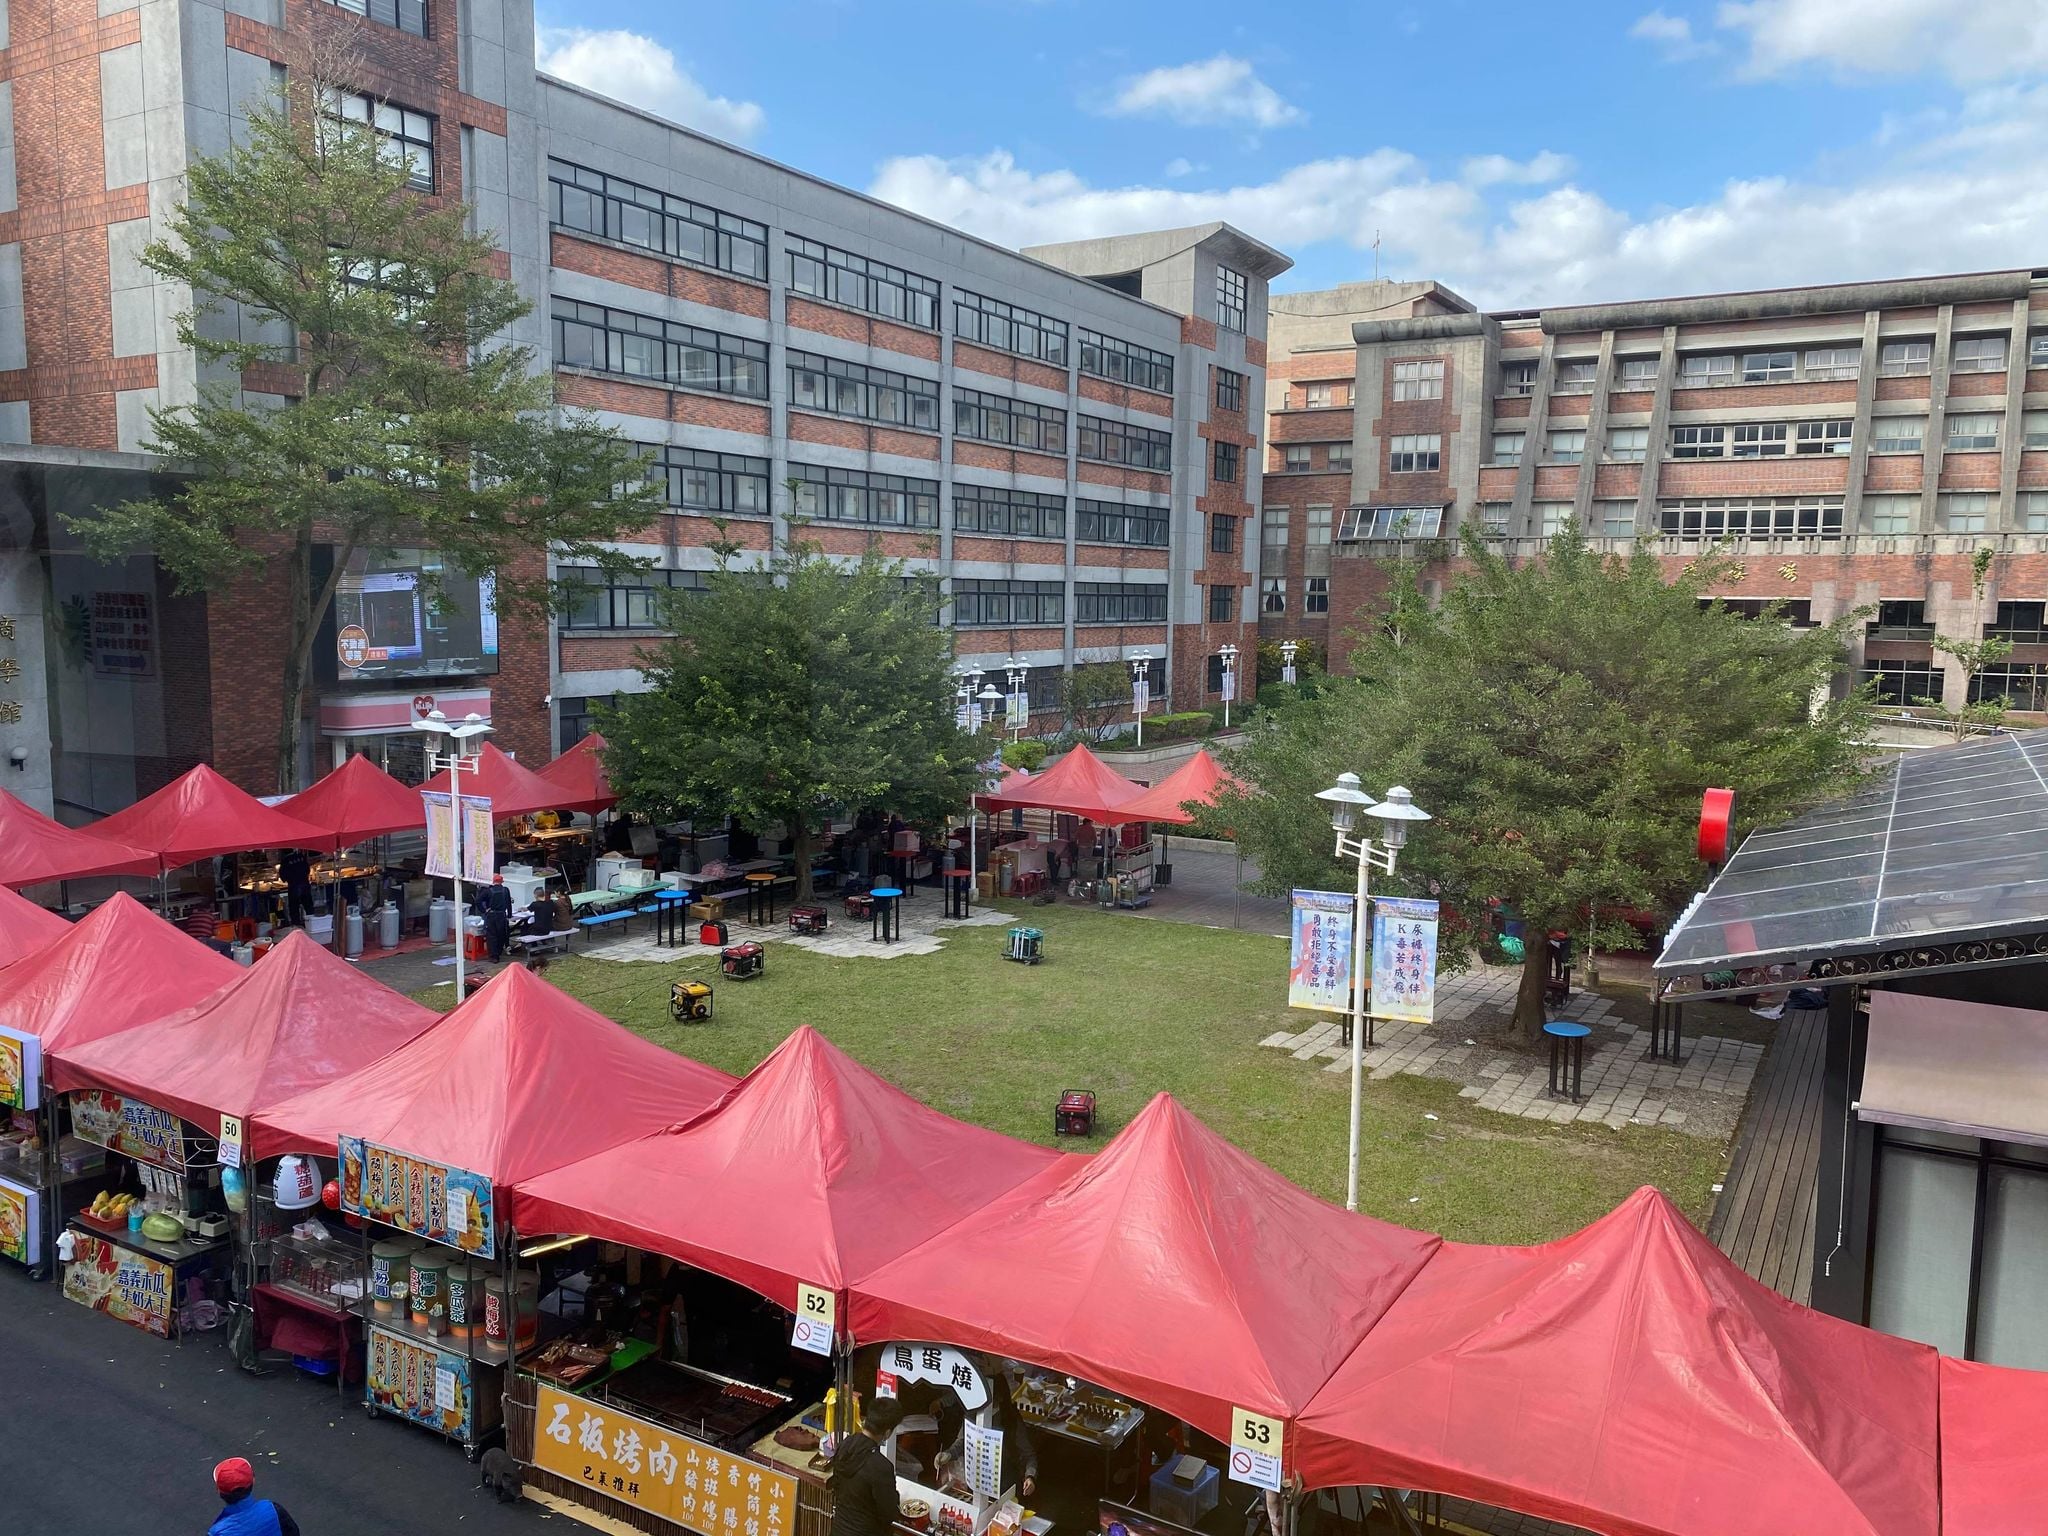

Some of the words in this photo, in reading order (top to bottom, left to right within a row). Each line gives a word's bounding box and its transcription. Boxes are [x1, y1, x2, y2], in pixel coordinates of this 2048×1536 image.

[124, 1107, 177, 1132] 嘉義木瓜
[225, 1122, 237, 1136] 50
[131, 1126, 180, 1153] 牛奶大王
[294, 1162, 314, 1200] 糖葫蘆
[390, 1162, 404, 1206] 冬瓜茶
[119, 1269, 167, 1296] 嘉義木瓜
[121, 1287, 167, 1318] 牛奶大王
[450, 1283, 465, 1323] 冬瓜茶
[806, 1293, 826, 1314] 52
[391, 1346, 402, 1386] 冬瓜茶
[894, 1346, 973, 1391] 鳥蛋燒
[546, 1403, 678, 1485] 石板烤肉
[1244, 1419, 1270, 1444] 53
[682, 1448, 700, 1513] 山豬肉
[682, 1511, 695, 1523] 100
[744, 1472, 762, 1536] 竹筒飯
[702, 1519, 715, 1531] 100
